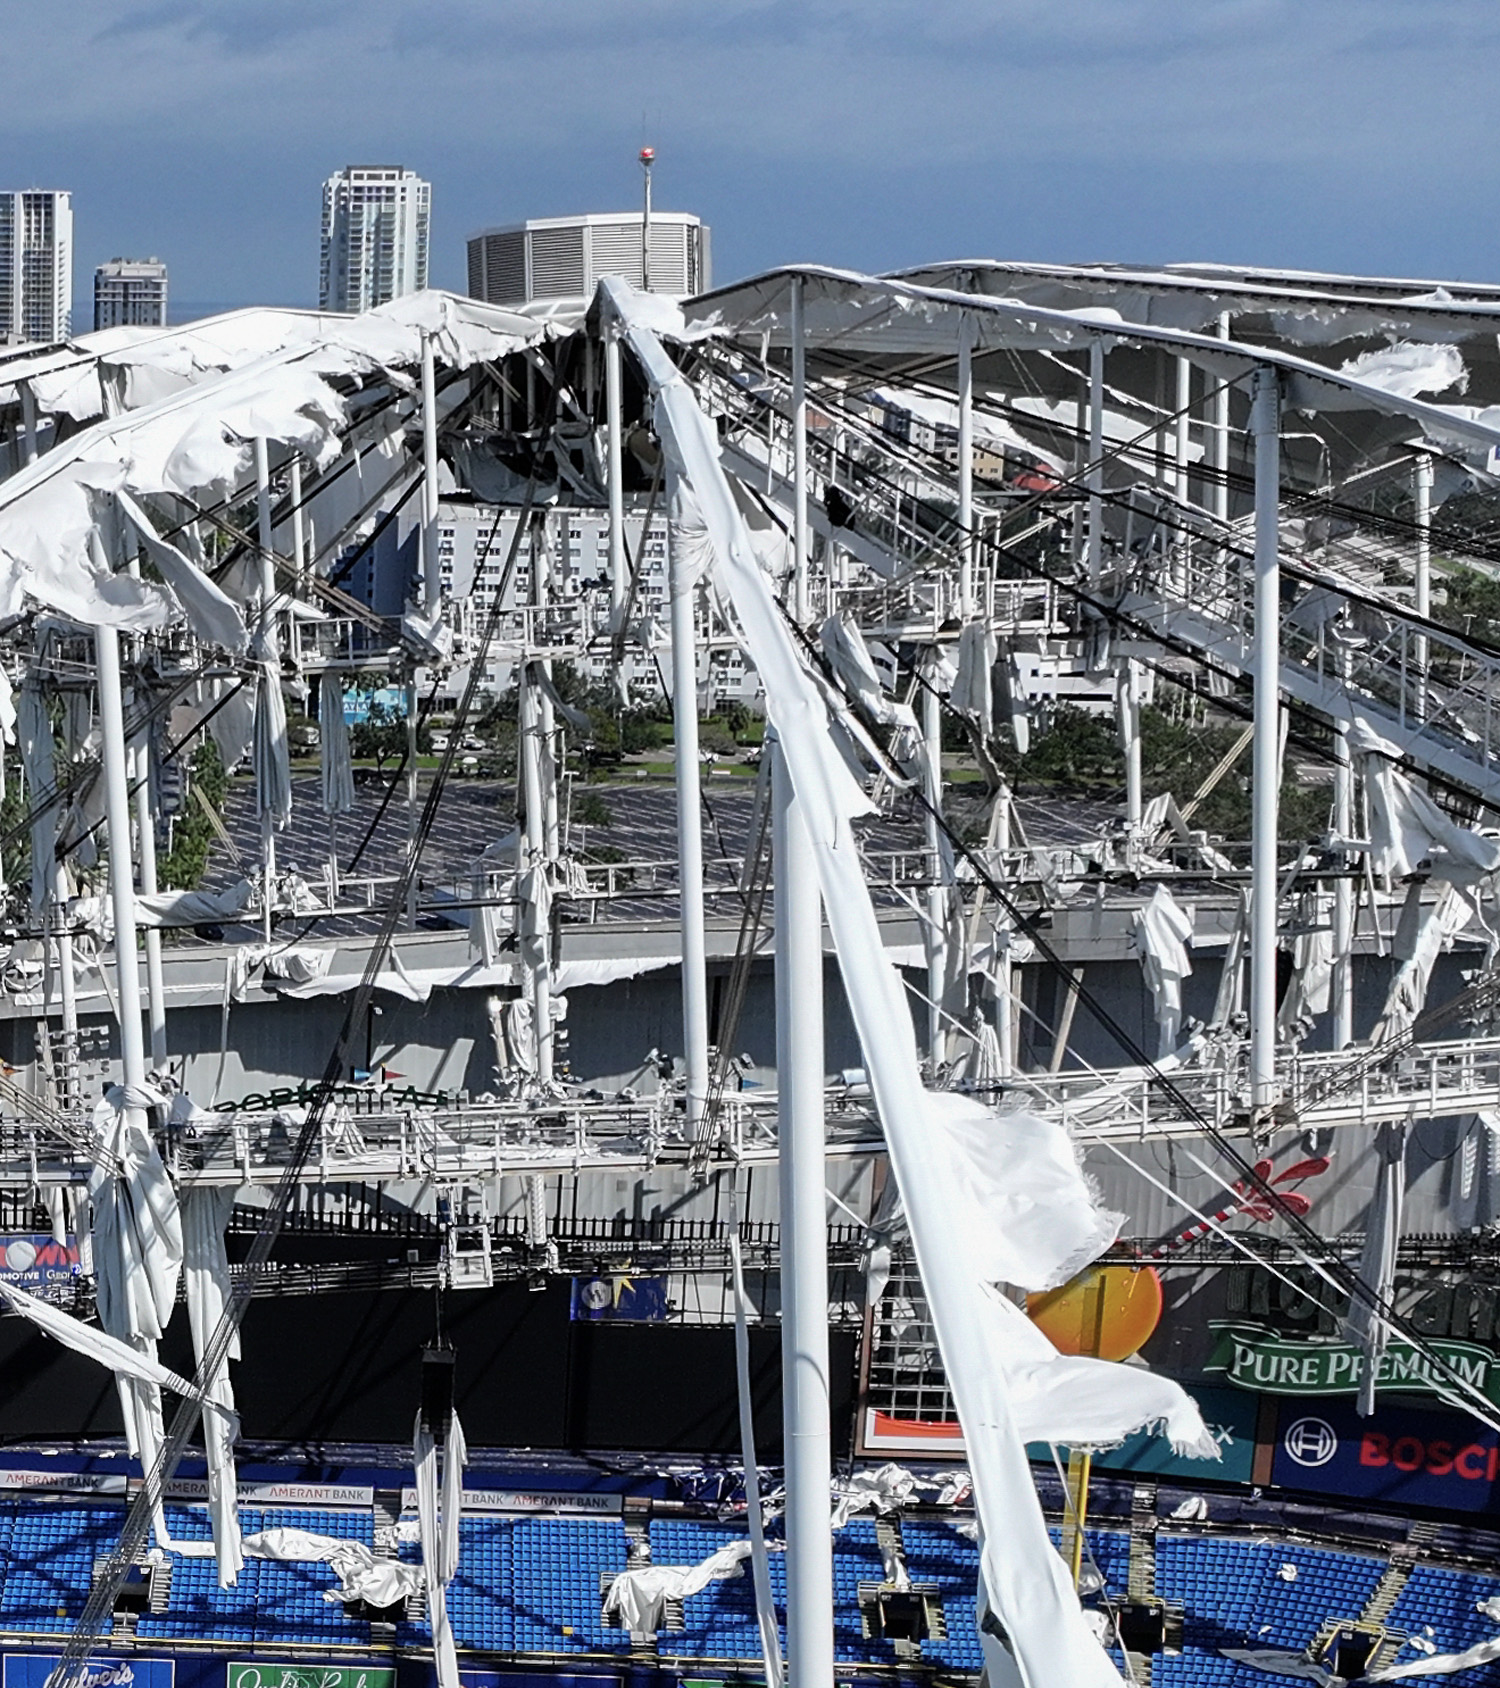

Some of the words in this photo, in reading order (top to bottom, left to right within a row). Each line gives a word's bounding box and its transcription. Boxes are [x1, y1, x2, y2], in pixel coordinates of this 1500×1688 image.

[1231, 1343, 1320, 1386] PURE
[5, 1472, 66, 1487] AMERANT
[67, 1475, 99, 1489] BANK
[268, 1487, 331, 1499] AMERANT
[333, 1489, 365, 1501] BANK
[470, 1492, 504, 1506] BANK
[513, 1494, 574, 1508] AMERANT
[575, 1496, 610, 1510] BANK
